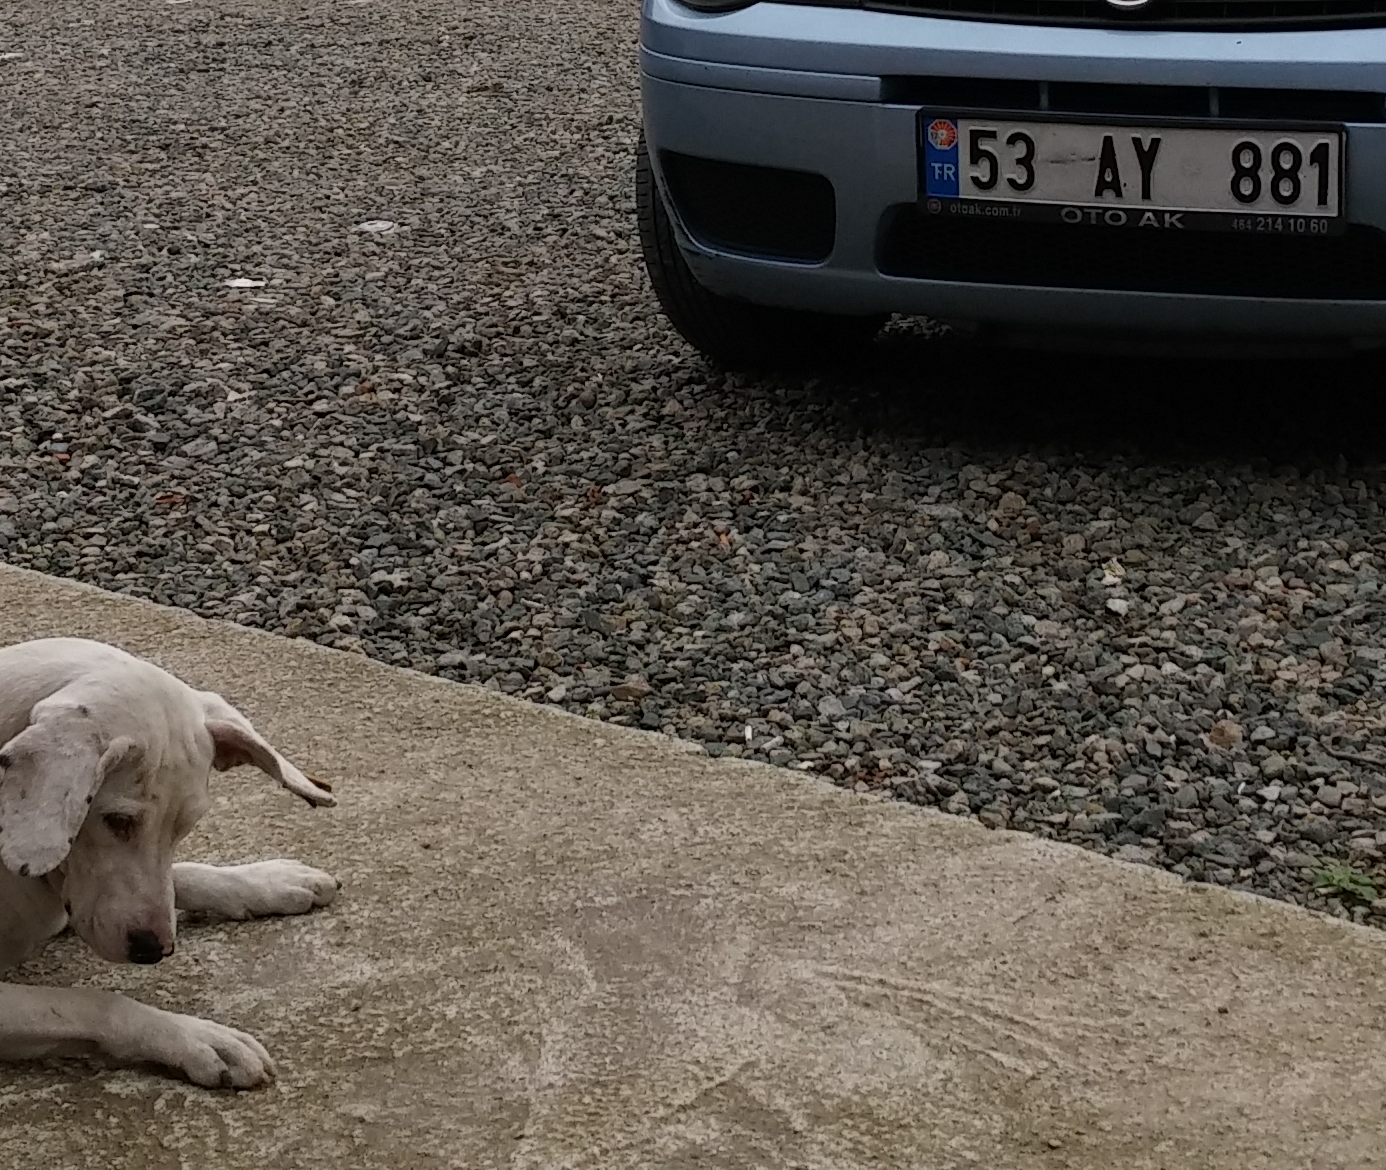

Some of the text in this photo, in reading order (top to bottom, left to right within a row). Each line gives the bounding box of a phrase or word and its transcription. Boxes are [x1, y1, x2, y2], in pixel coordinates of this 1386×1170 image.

[930, 162, 956, 182] TR
[968, 129, 1331, 207] 53 AY 881
[1059, 206, 1185, 230] OTO AK
[1256, 216, 1283, 232] 214
[1288, 217, 1306, 233] 10
[1309, 218, 1329, 234] 60
